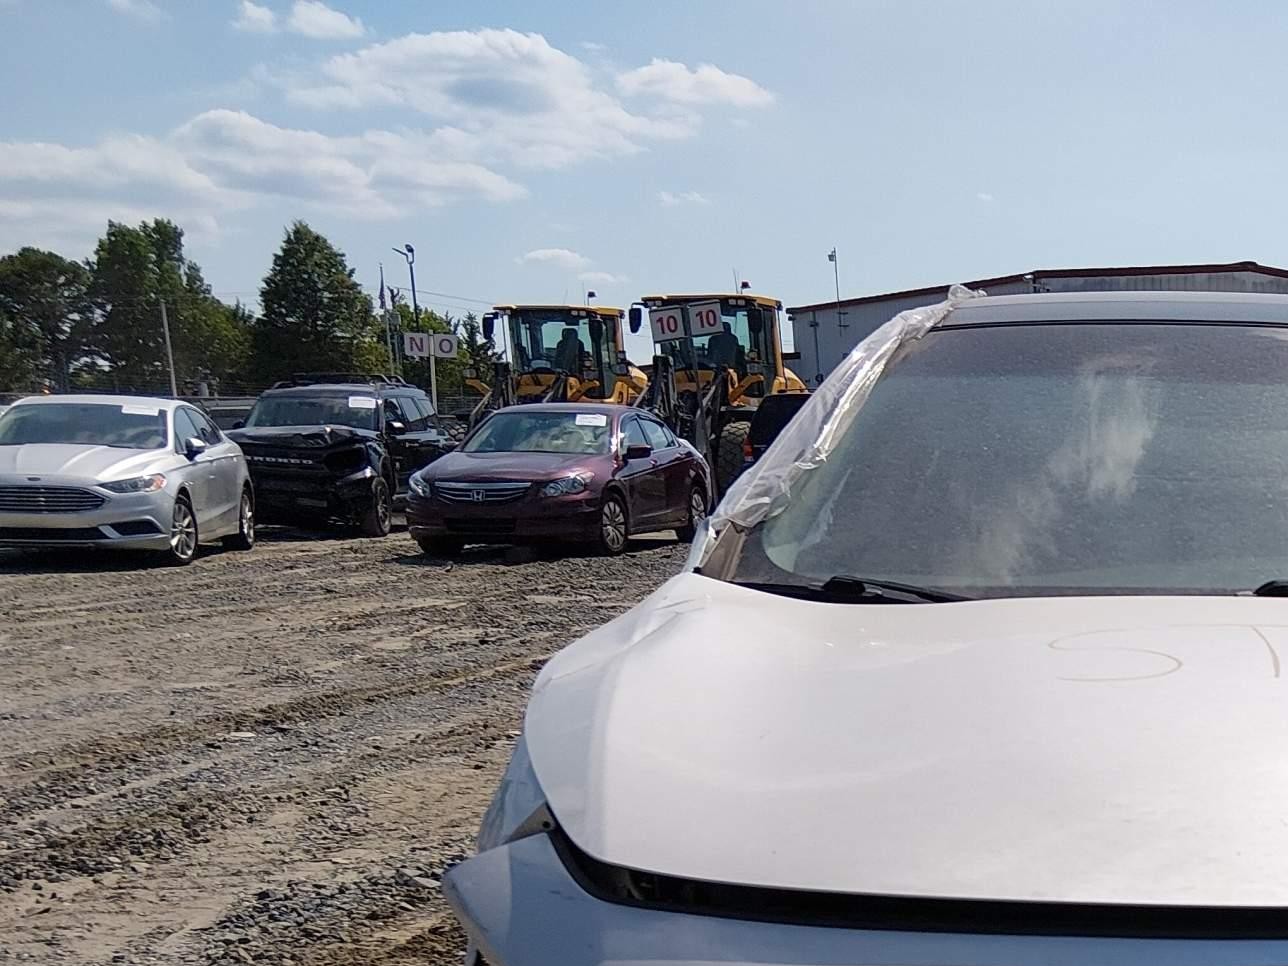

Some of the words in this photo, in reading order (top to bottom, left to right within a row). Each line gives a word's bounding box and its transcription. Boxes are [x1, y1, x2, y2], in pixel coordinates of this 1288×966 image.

[656, 315, 678, 335] 10
[695, 309, 717, 329] 10
[409, 336, 424, 353] N
